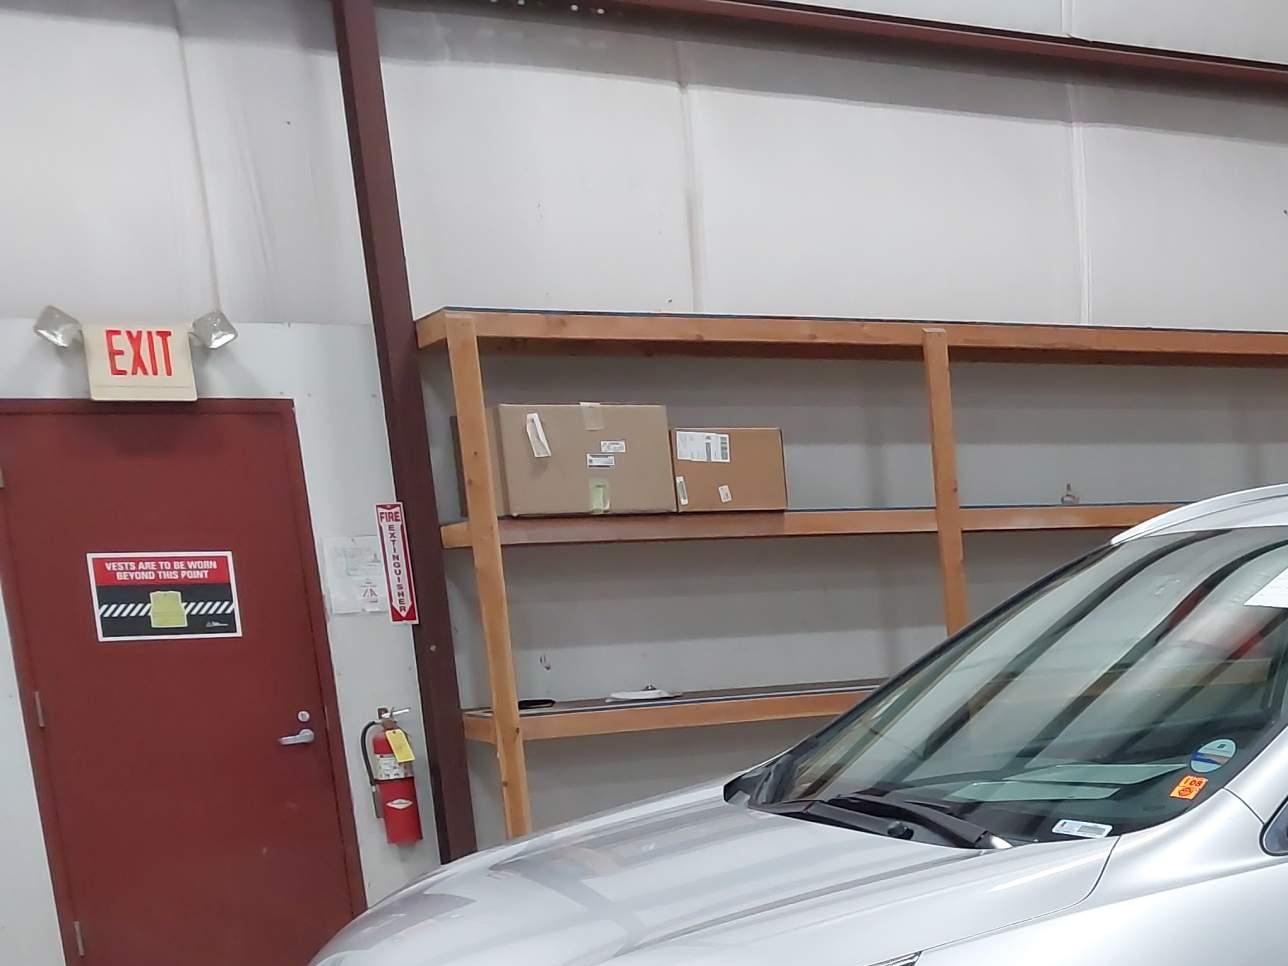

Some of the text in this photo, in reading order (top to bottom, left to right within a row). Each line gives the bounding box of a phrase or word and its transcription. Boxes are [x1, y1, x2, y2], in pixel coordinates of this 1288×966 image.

[105, 329, 173, 377] EXIT
[379, 511, 401, 522] FIRE
[105, 560, 217, 571] VESTS ARE TO BE WORN
[388, 524, 407, 612] EXTINGUISHER
[116, 570, 209, 580] BEYOND THIS POINT
